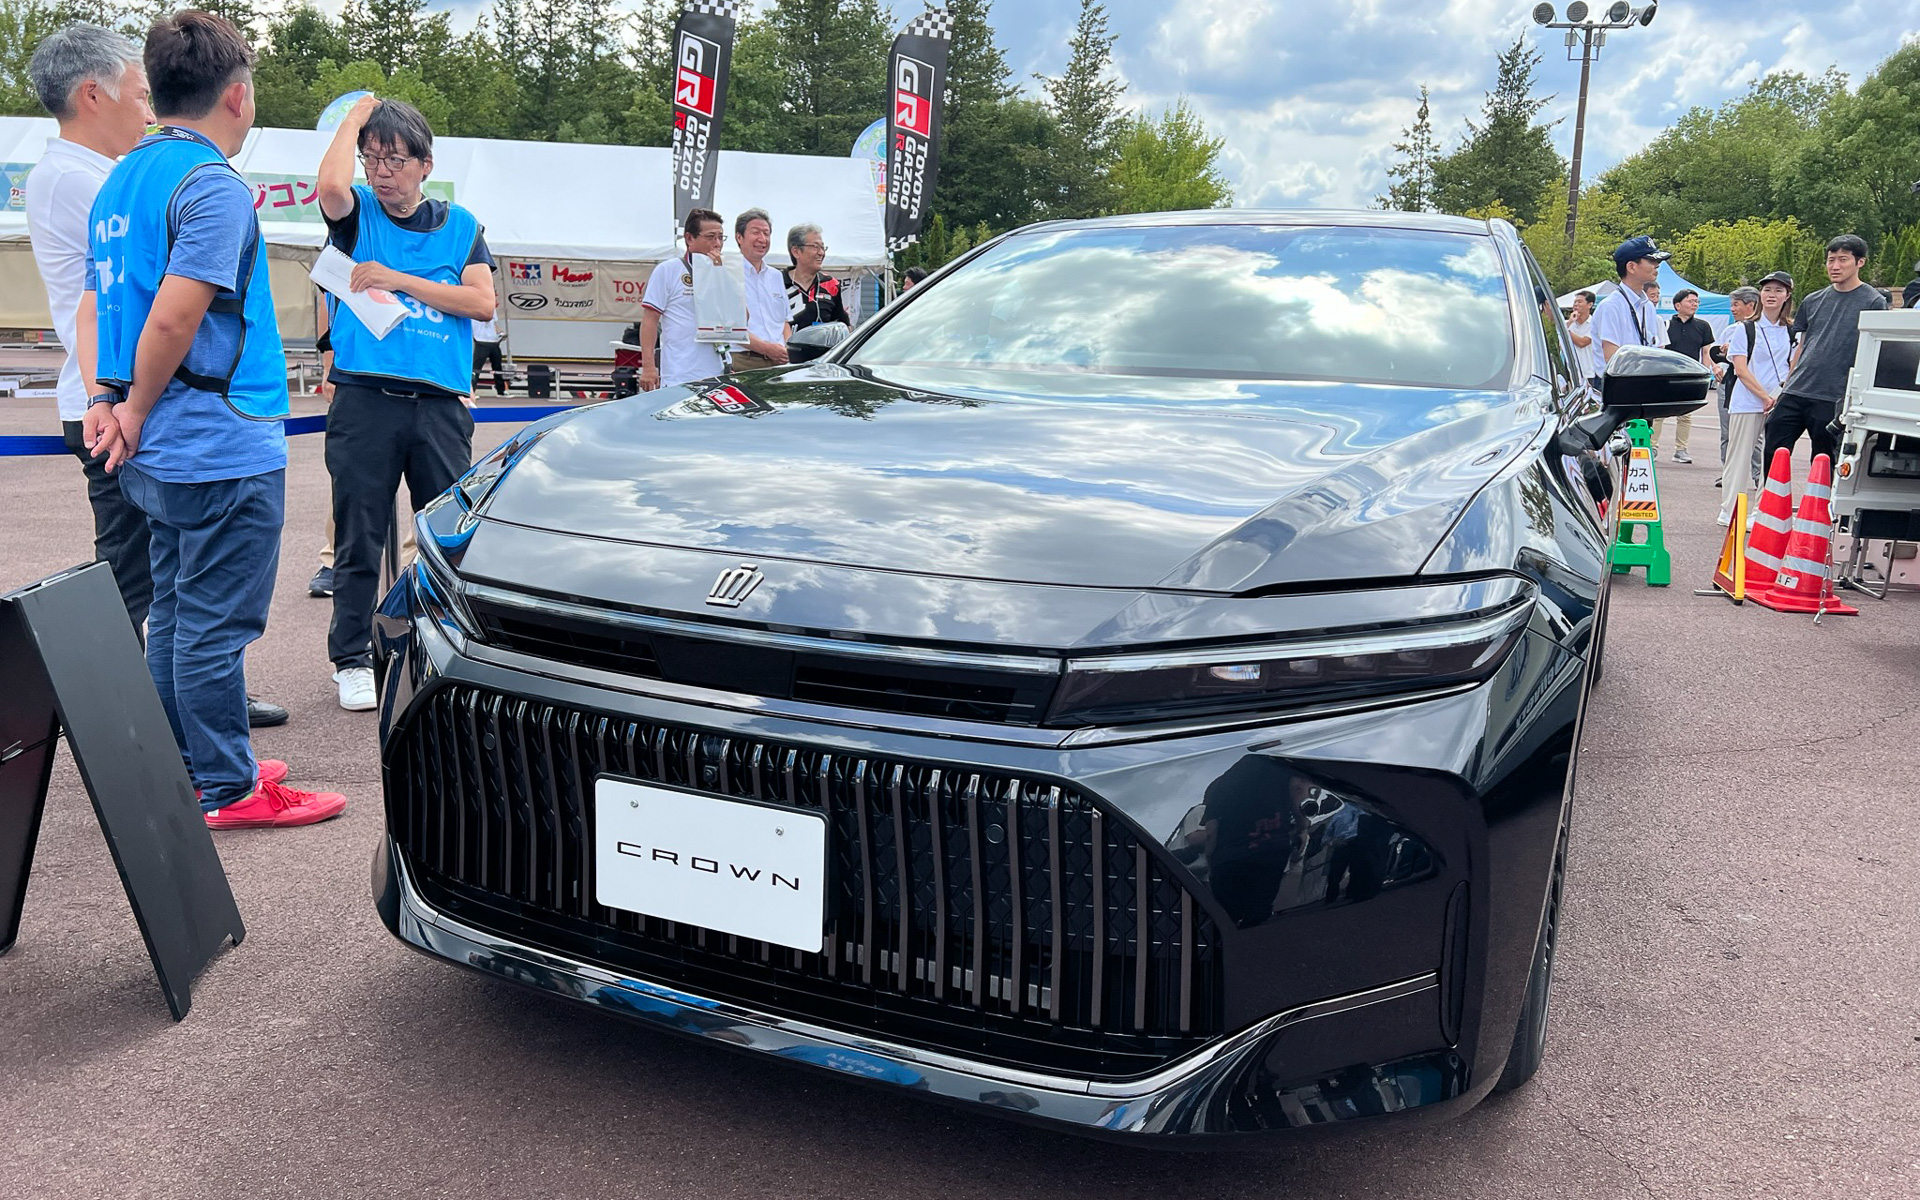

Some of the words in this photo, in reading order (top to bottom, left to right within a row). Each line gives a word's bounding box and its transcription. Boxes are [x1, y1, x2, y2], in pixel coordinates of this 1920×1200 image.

[678, 36, 704, 107] GR
[897, 58, 919, 128] GR
[680, 114, 697, 191] GAZOO
[690, 120, 712, 200] TOYOTA
[888, 133, 905, 205] Racing
[900, 136, 916, 210] GAZOO
[909, 141, 929, 220] TOYOTA
[512, 278, 542, 287] TAMIYA
[1628, 483, 1649, 493] ん中
[1629, 468, 1648, 477] ガス
[617, 841, 800, 891] CROWN
